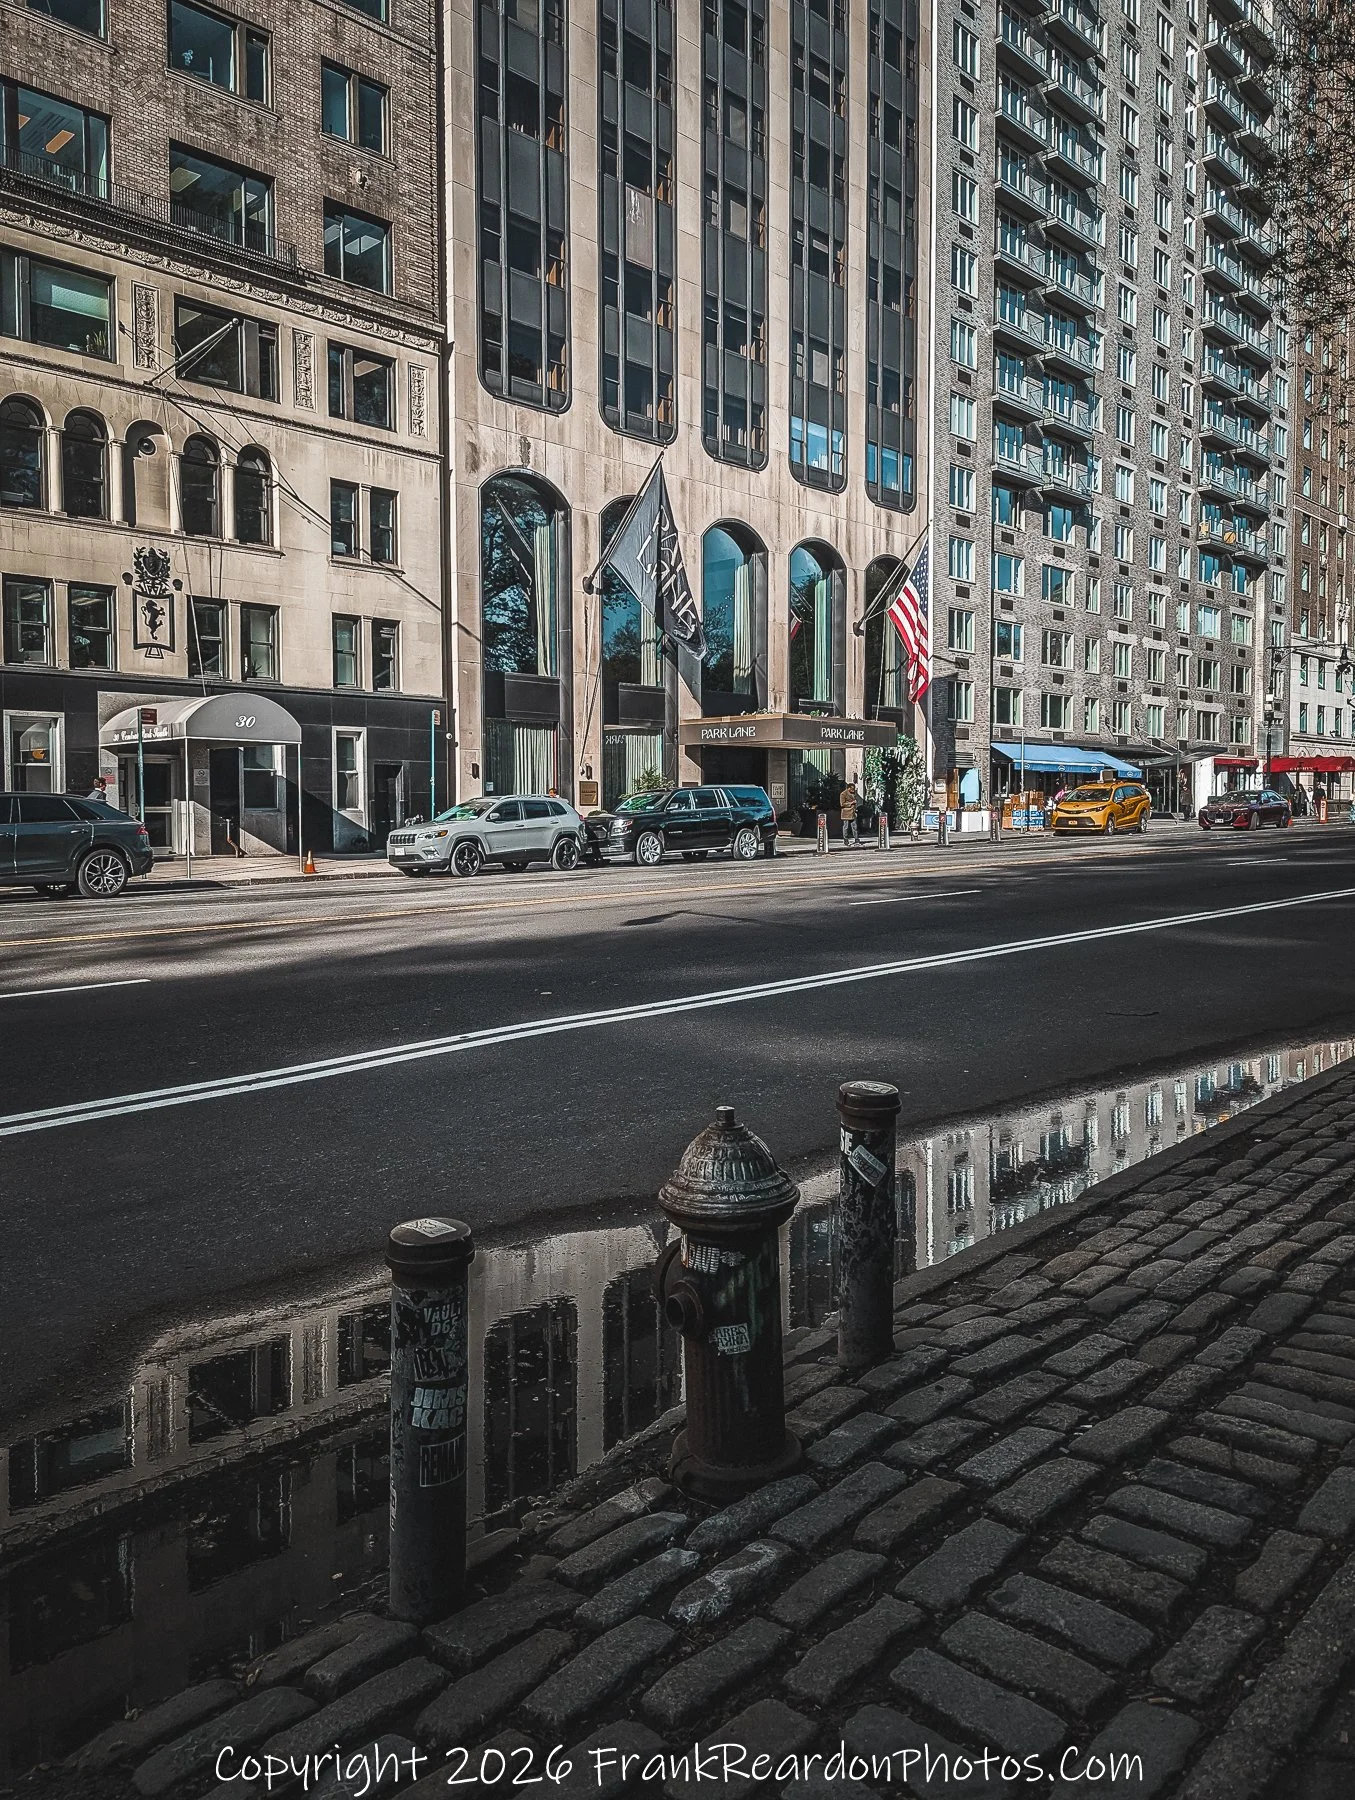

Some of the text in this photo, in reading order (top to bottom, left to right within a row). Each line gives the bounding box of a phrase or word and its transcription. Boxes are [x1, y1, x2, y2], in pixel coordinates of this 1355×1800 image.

[235, 716, 256, 728] 30
[121, 730, 139, 741] Centra
[701, 726, 756, 740] PARK LANE
[821, 727, 865, 741] PARK LANE
